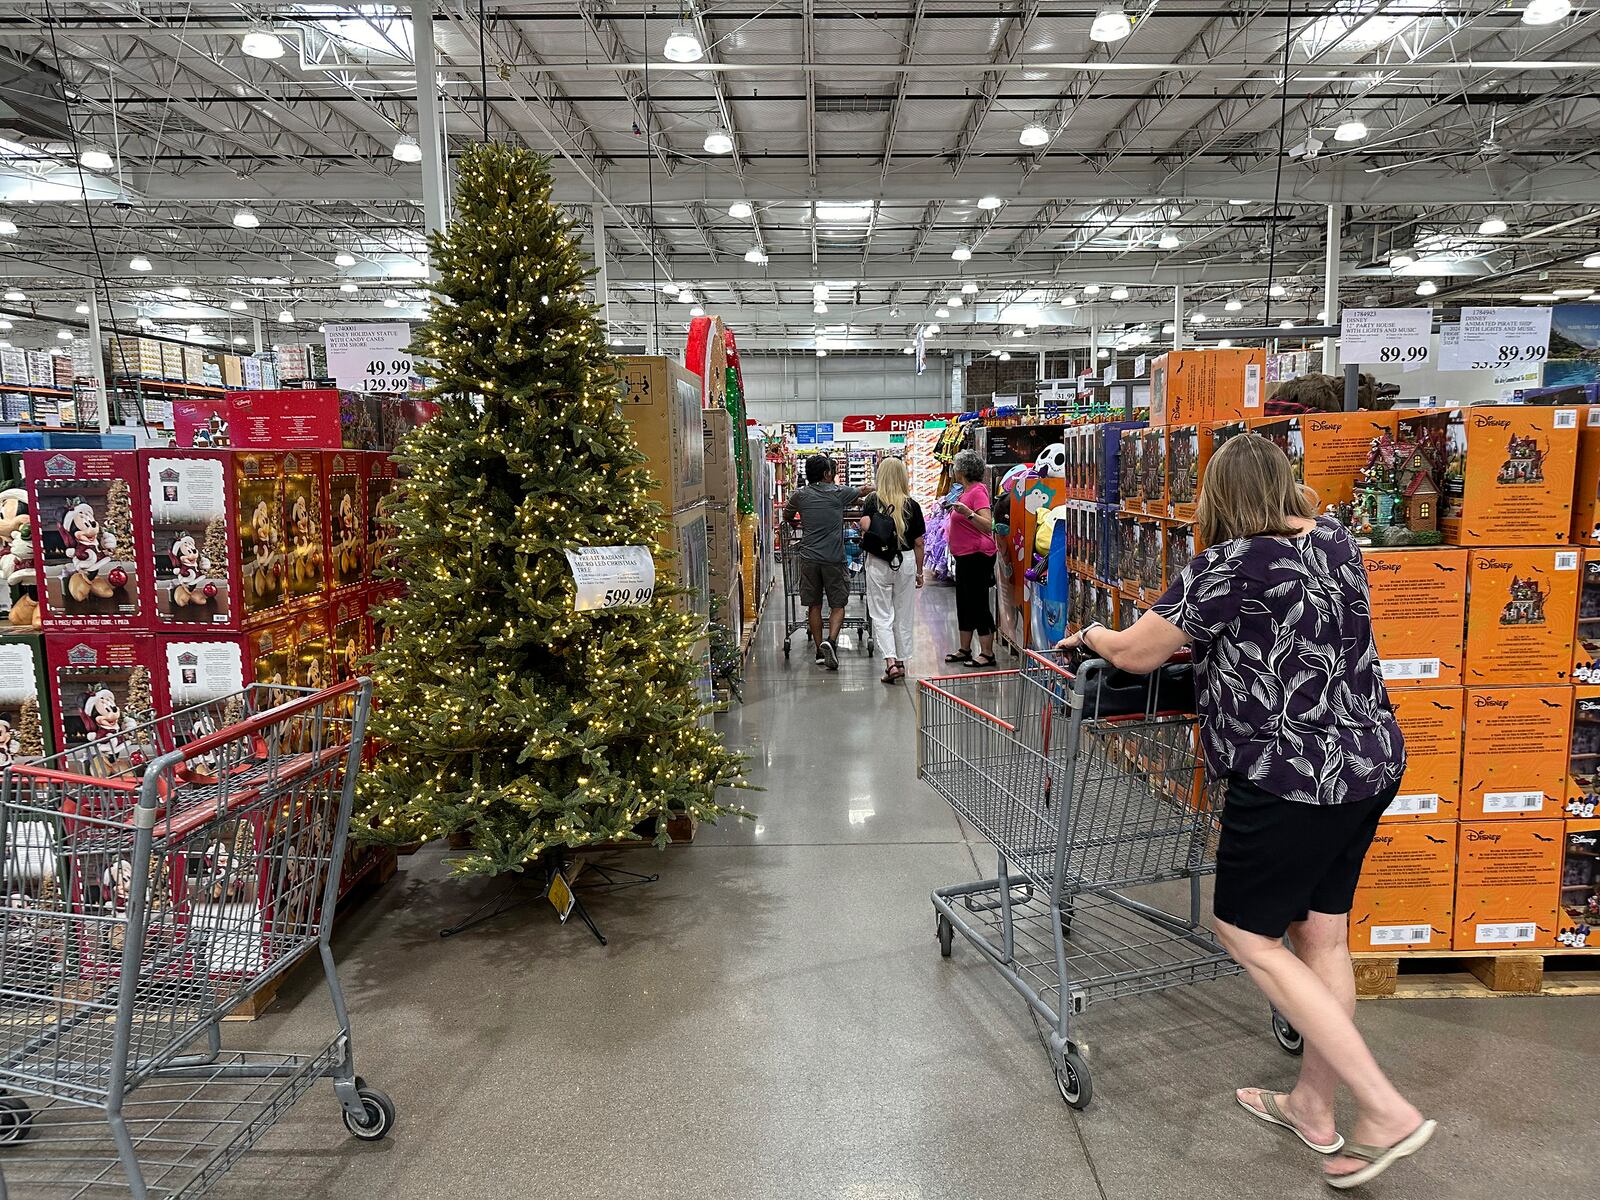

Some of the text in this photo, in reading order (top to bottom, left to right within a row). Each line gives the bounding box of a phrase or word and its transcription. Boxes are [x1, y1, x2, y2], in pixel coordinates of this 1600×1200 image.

[1380, 346, 1428, 362] 89.99
[1498, 345, 1546, 361] 89.99
[366, 360, 411, 375] 49.99
[363, 379, 407, 391] 129.99
[1171, 396, 1183, 422] Disney
[1308, 420, 1342, 433] Disney
[1473, 414, 1512, 430] Disney
[1364, 559, 1402, 575] Disney
[1476, 557, 1513, 573] Disney
[603, 587, 652, 607] 599.99
[1472, 695, 1509, 710] Disney
[1372, 836, 1394, 846] isney
[1465, 829, 1502, 844] Disney
[1570, 834, 1597, 846] Disney
